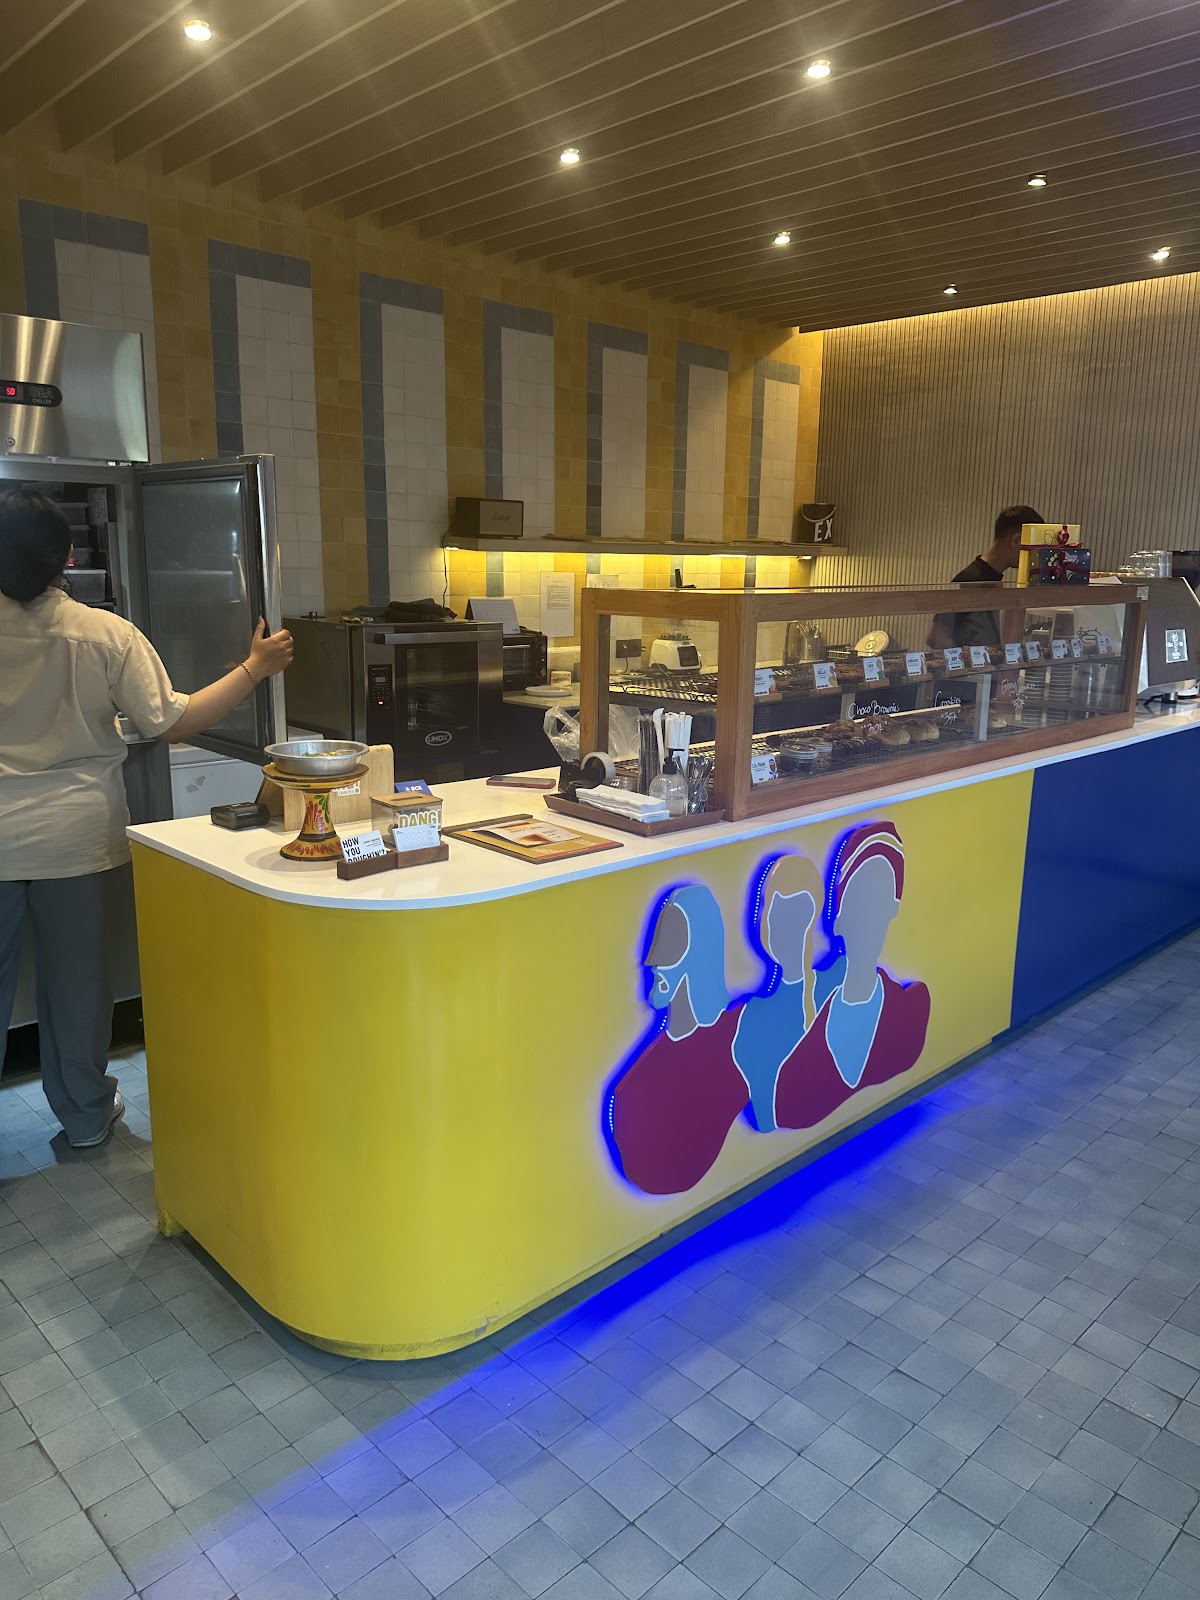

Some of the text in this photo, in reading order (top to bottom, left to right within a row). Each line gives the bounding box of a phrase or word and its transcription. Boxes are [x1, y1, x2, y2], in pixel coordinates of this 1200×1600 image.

[814, 518, 833, 543] EX
[848, 702, 871, 719] Choco
[342, 837, 359, 848] HOW
[345, 847, 361, 857] YOU
